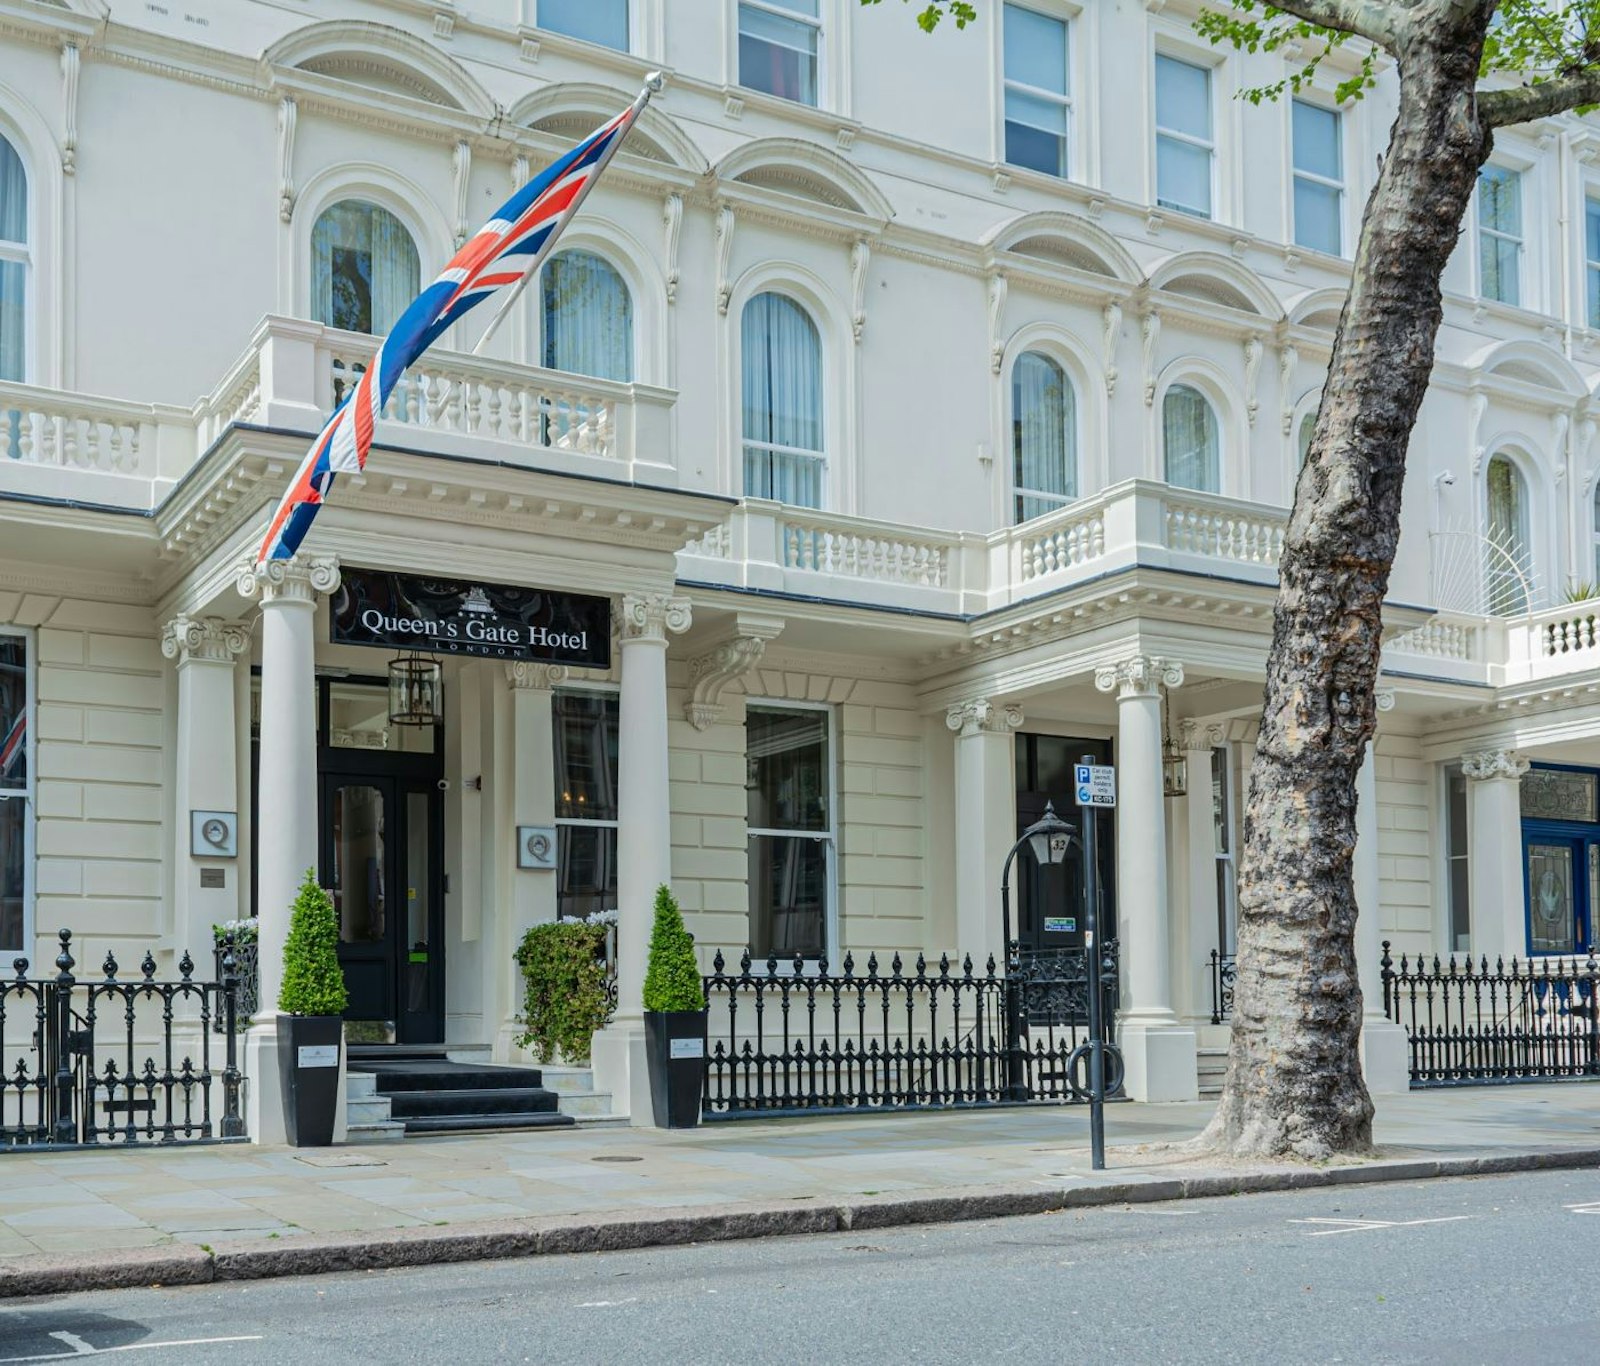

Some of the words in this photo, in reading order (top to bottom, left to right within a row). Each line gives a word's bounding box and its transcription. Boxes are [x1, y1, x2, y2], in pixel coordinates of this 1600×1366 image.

[361, 609, 458, 638] Queen's
[465, 620, 519, 644] Gate
[528, 625, 588, 650] Hotel
[436, 643, 521, 657] LONDON
[1079, 768, 1088, 782] P
[202, 819, 229, 851] Q
[1052, 839, 1066, 851] 32
[527, 834, 552, 863] Q
